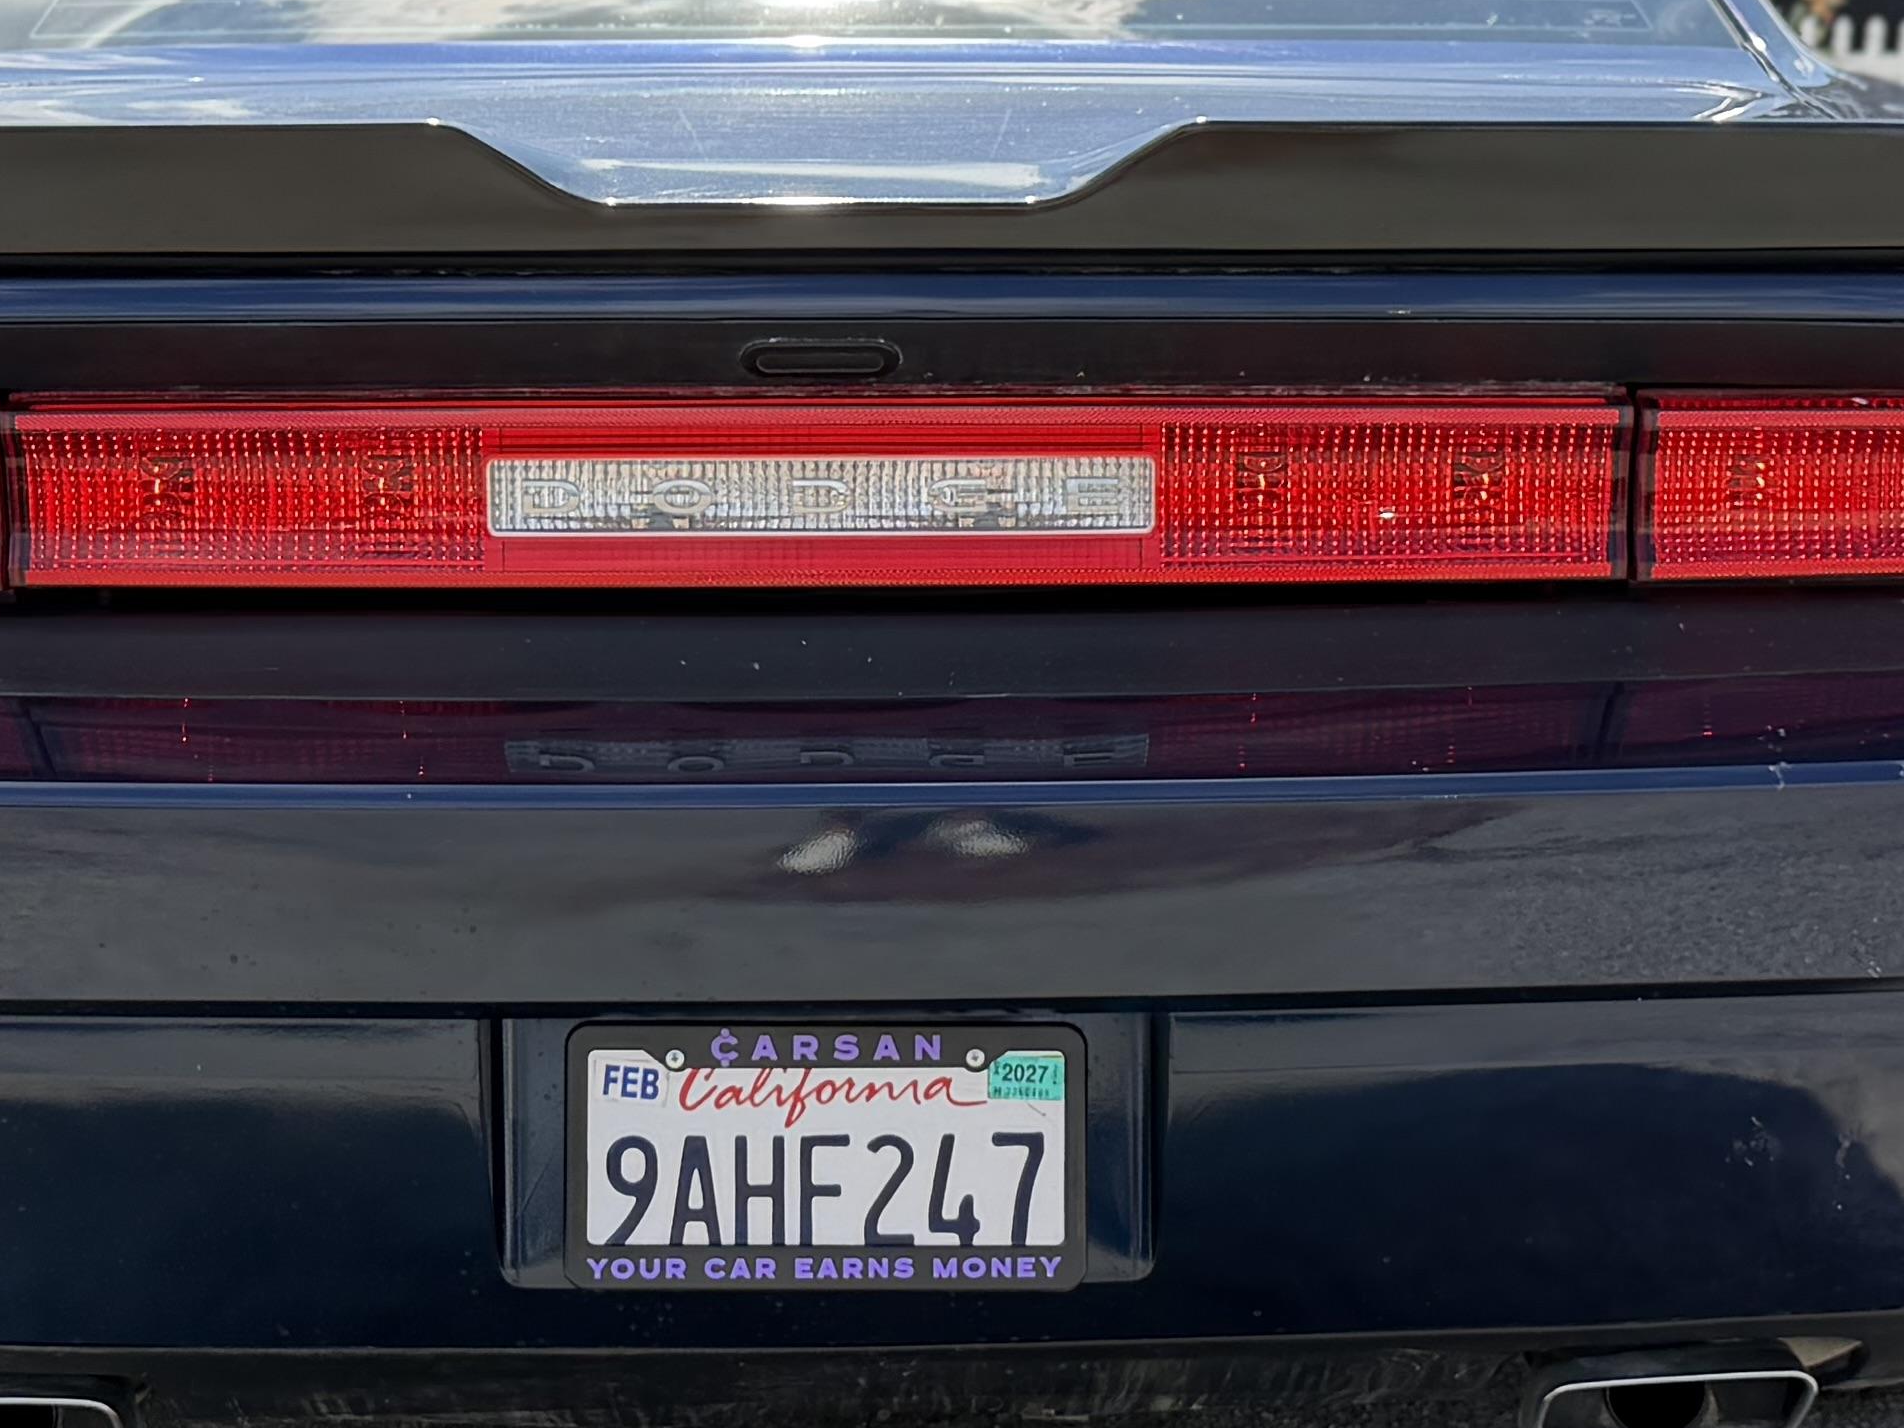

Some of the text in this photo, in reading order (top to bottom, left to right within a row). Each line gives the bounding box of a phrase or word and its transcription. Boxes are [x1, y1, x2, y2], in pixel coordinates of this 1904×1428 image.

[521, 477, 1119, 518] DODGE
[602, 1063, 660, 1101] FEB
[1001, 1062, 1049, 1084] 2027
[678, 1067, 988, 1129] California
[605, 1131, 1046, 1246] 9AHF247
[586, 1256, 1062, 1280] YOUR CAR EARNS MONEY
